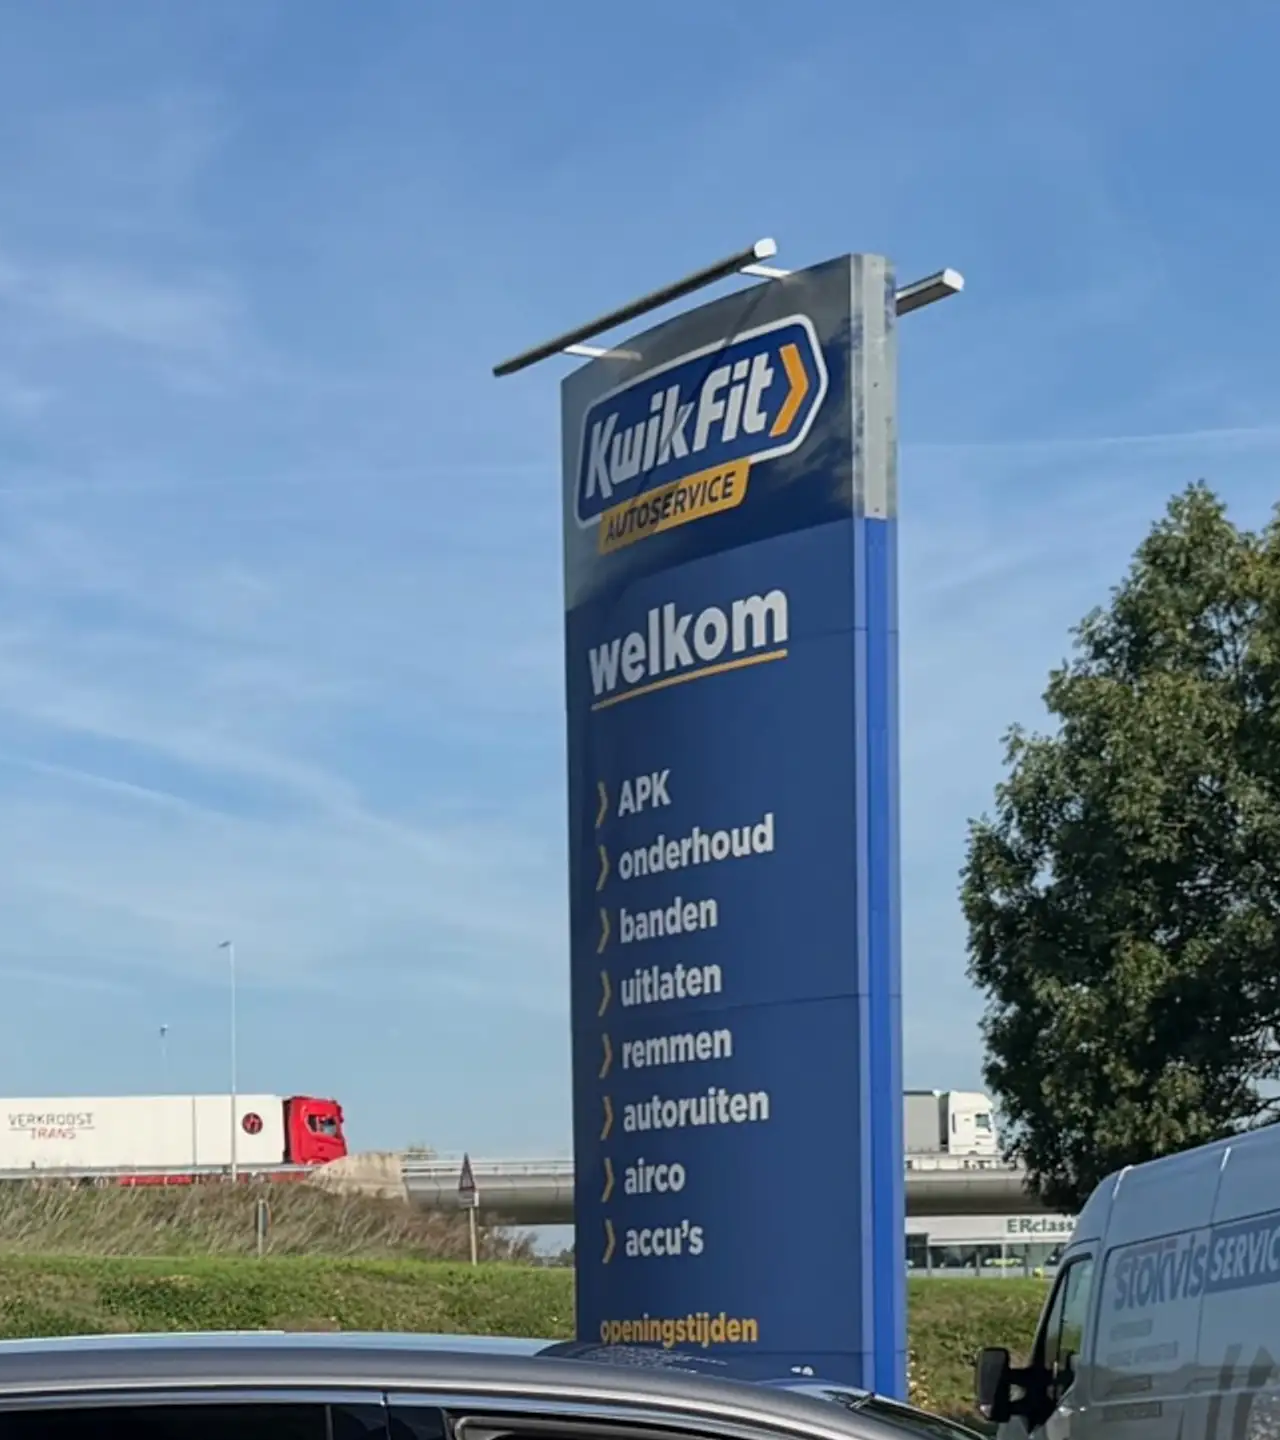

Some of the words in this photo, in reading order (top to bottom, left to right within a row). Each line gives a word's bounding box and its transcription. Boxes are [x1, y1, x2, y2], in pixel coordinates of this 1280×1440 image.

[607, 471, 736, 542] AUTOSERVICE
[588, 588, 789, 697] welkom
[618, 769, 672, 817] APK
[619, 812, 775, 880] onderhoud
[620, 897, 719, 944] banden
[621, 963, 723, 1007] uitlaten
[622, 1028, 733, 1070] remmen
[623, 1087, 770, 1132] autoruiten
[30, 1127, 77, 1140] TRANS
[624, 1158, 686, 1195] airco
[625, 1220, 705, 1257] accu's
[600, 1312, 760, 1348] openingstijden
